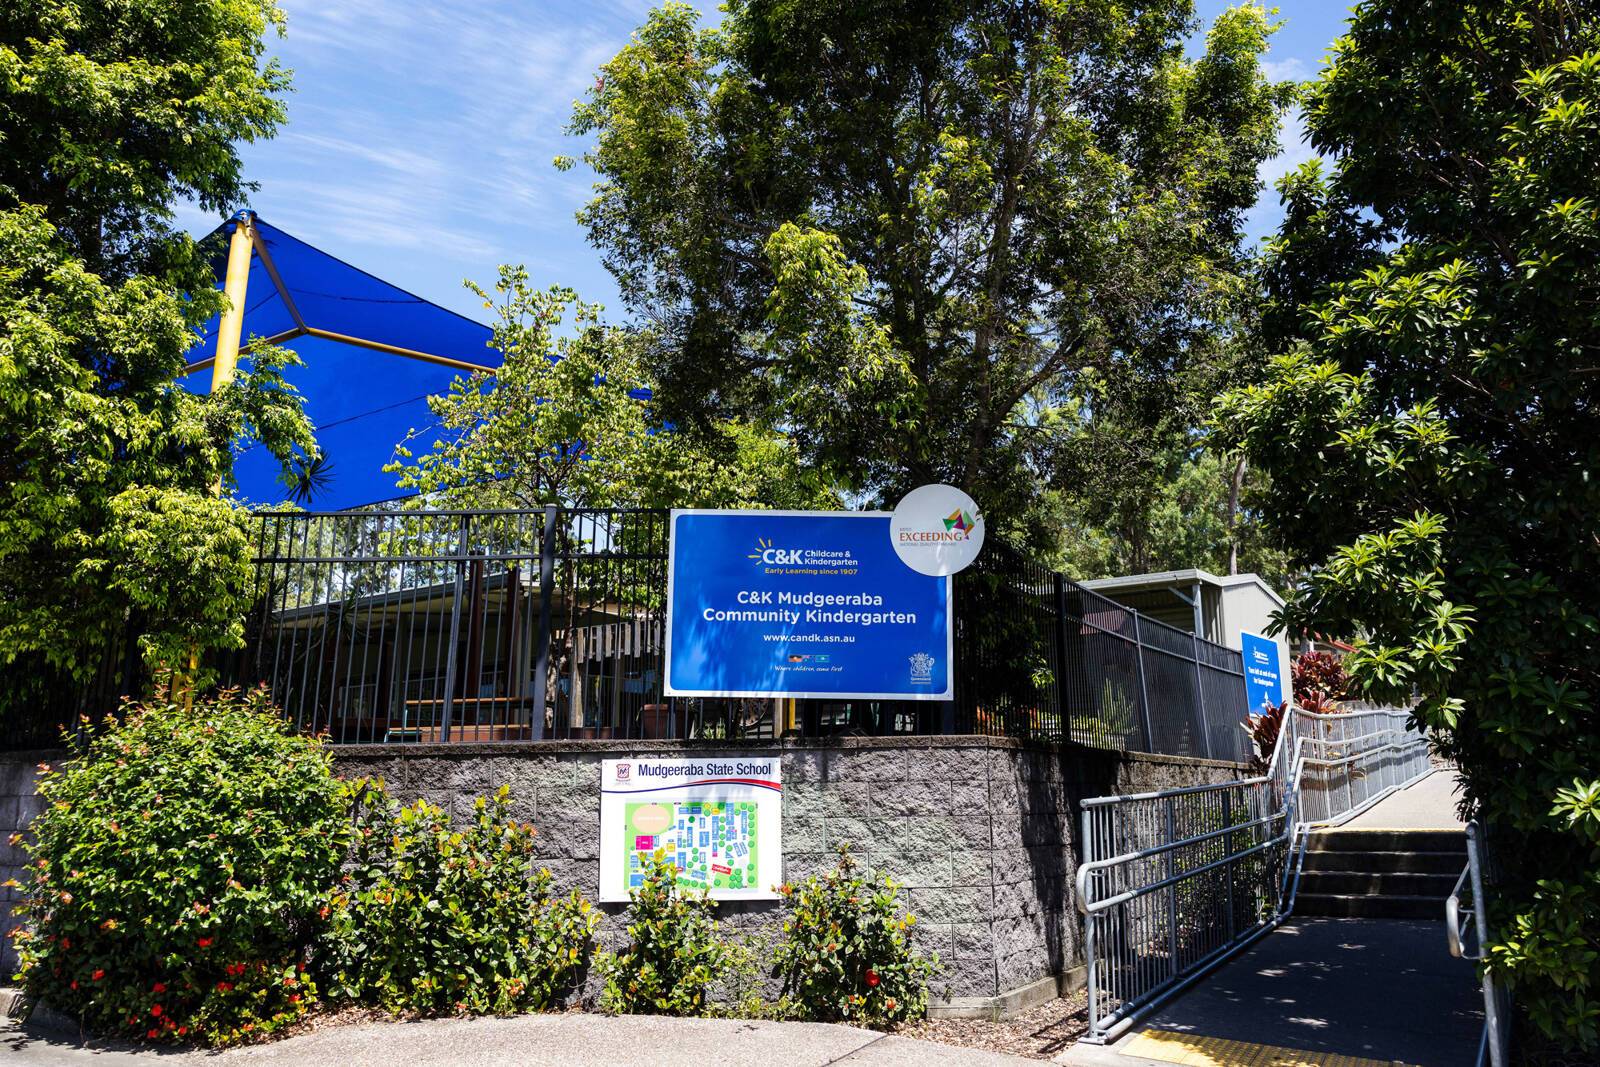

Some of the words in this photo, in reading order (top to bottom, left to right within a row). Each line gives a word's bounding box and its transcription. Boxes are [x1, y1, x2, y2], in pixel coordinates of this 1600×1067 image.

[900, 532, 962, 542] EXCEEDING
[762, 549, 803, 564] C&K
[804, 558, 858, 566] Kindergarten
[737, 591, 772, 604] C&K
[778, 592, 882, 608] Mudgeeraba
[703, 608, 800, 624] Community
[806, 610, 916, 626] Kindergarten
[763, 634, 855, 643] www.candk.asn.au
[638, 764, 703, 778] Mudgeeraba
[706, 764, 733, 775] State
[736, 763, 771, 775] School
